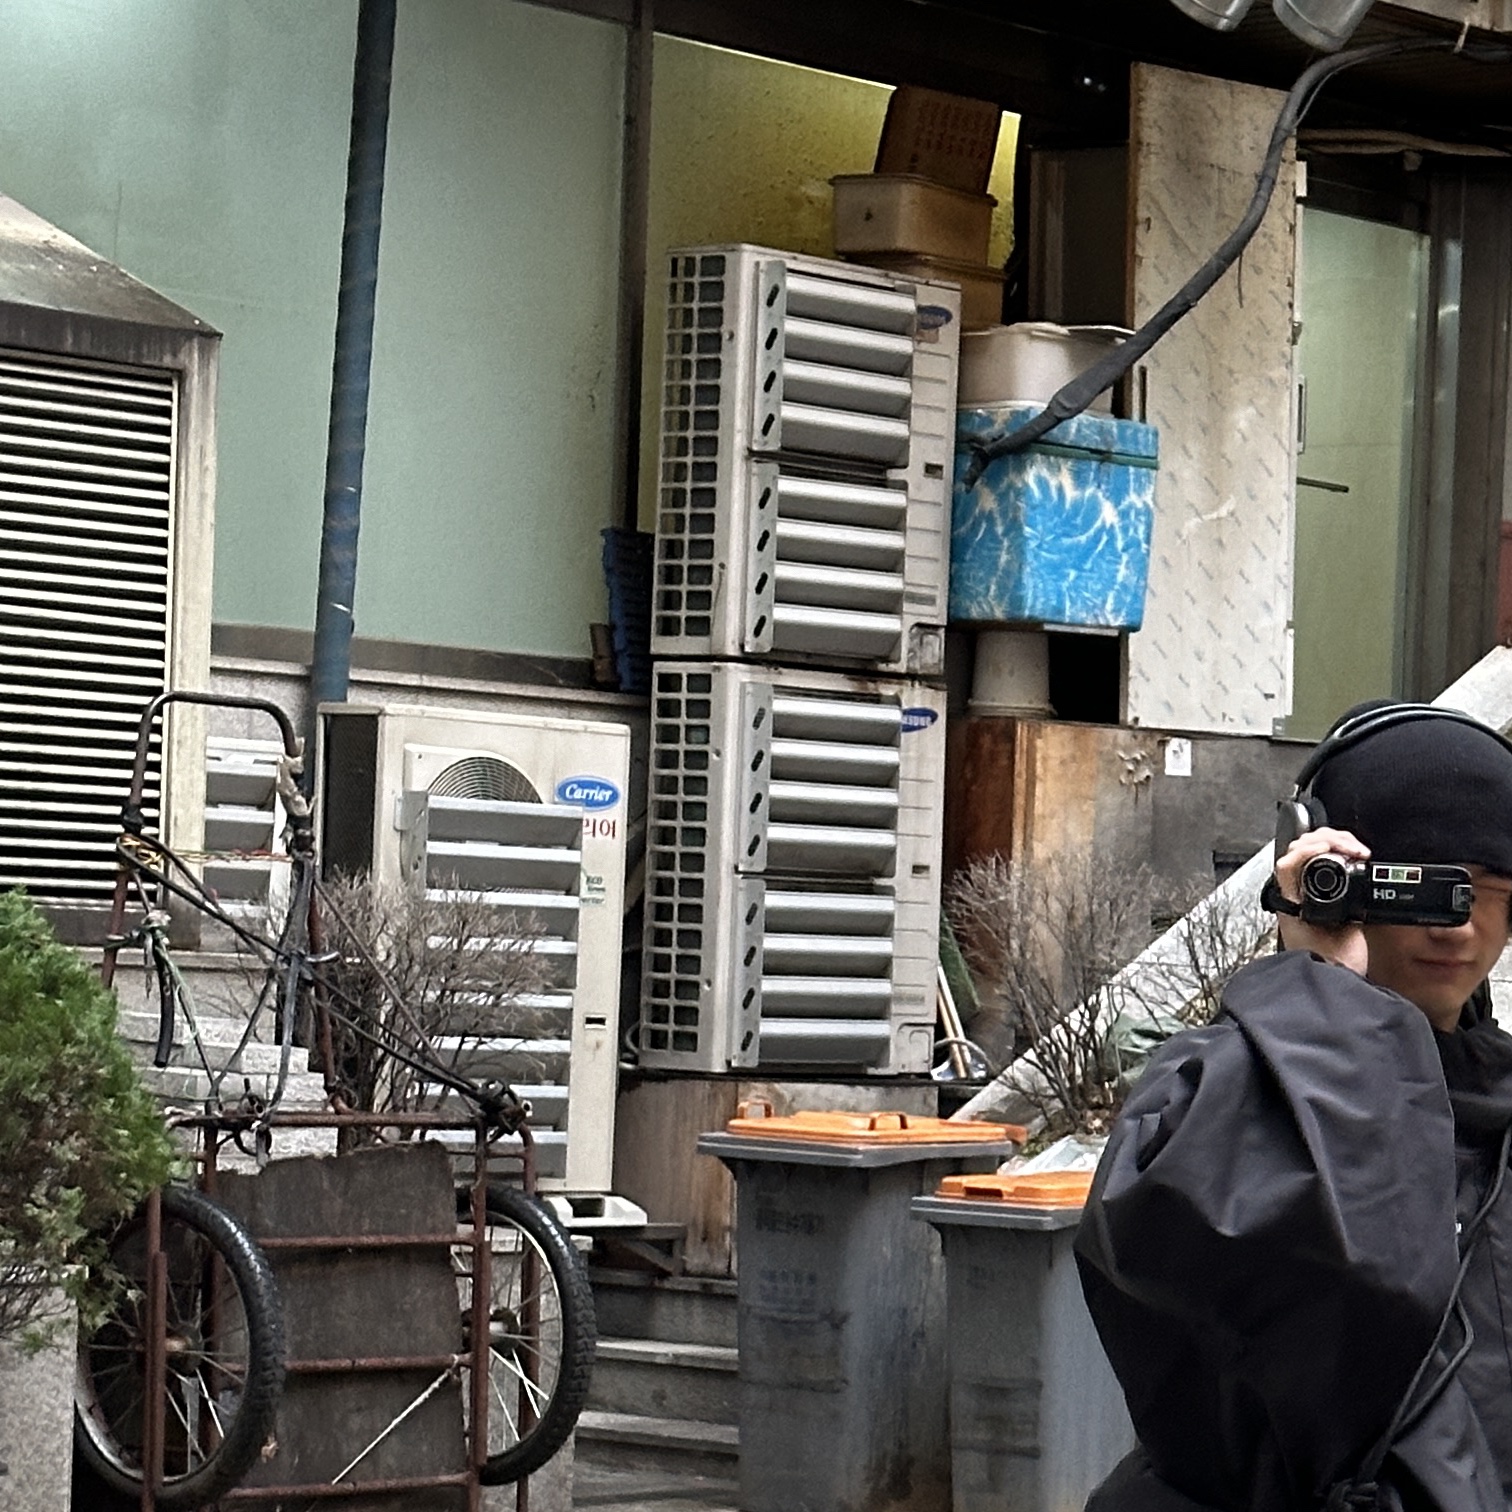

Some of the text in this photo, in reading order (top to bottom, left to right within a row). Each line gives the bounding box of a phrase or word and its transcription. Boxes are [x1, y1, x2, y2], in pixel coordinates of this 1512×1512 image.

[565, 784, 613, 802] Carrier
[582, 818, 617, 840] 리어
[1372, 888, 1397, 900] HD
